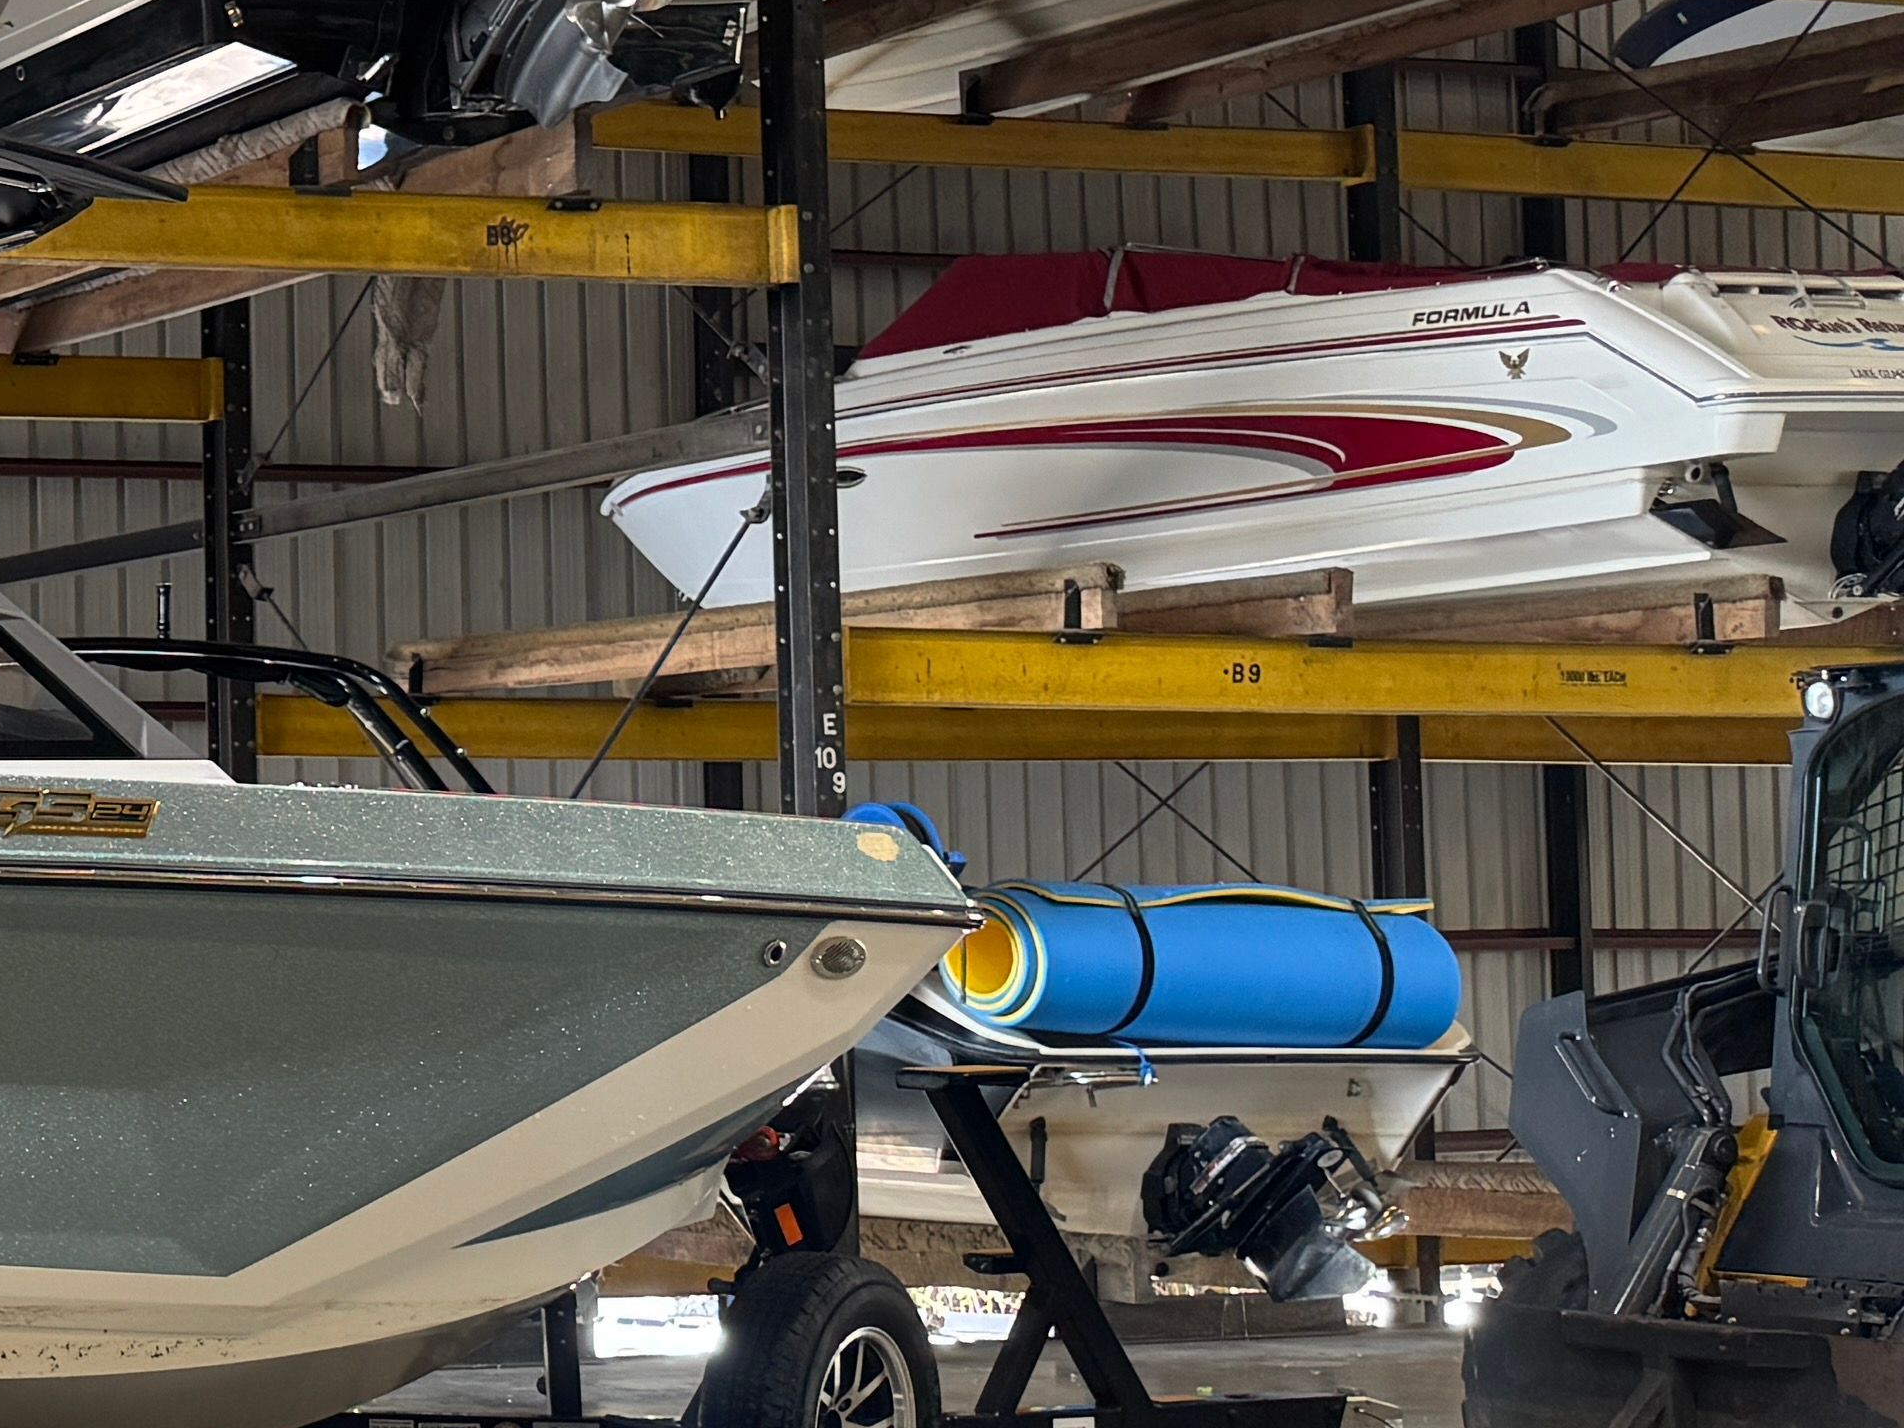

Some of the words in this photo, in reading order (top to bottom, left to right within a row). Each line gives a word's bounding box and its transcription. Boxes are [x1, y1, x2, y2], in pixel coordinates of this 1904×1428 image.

[1412, 301, 1532, 327] FORMULA
[1233, 662, 1261, 684] B9
[822, 713, 838, 736] E
[814, 746, 837, 770] 10
[832, 771, 846, 794] 9
